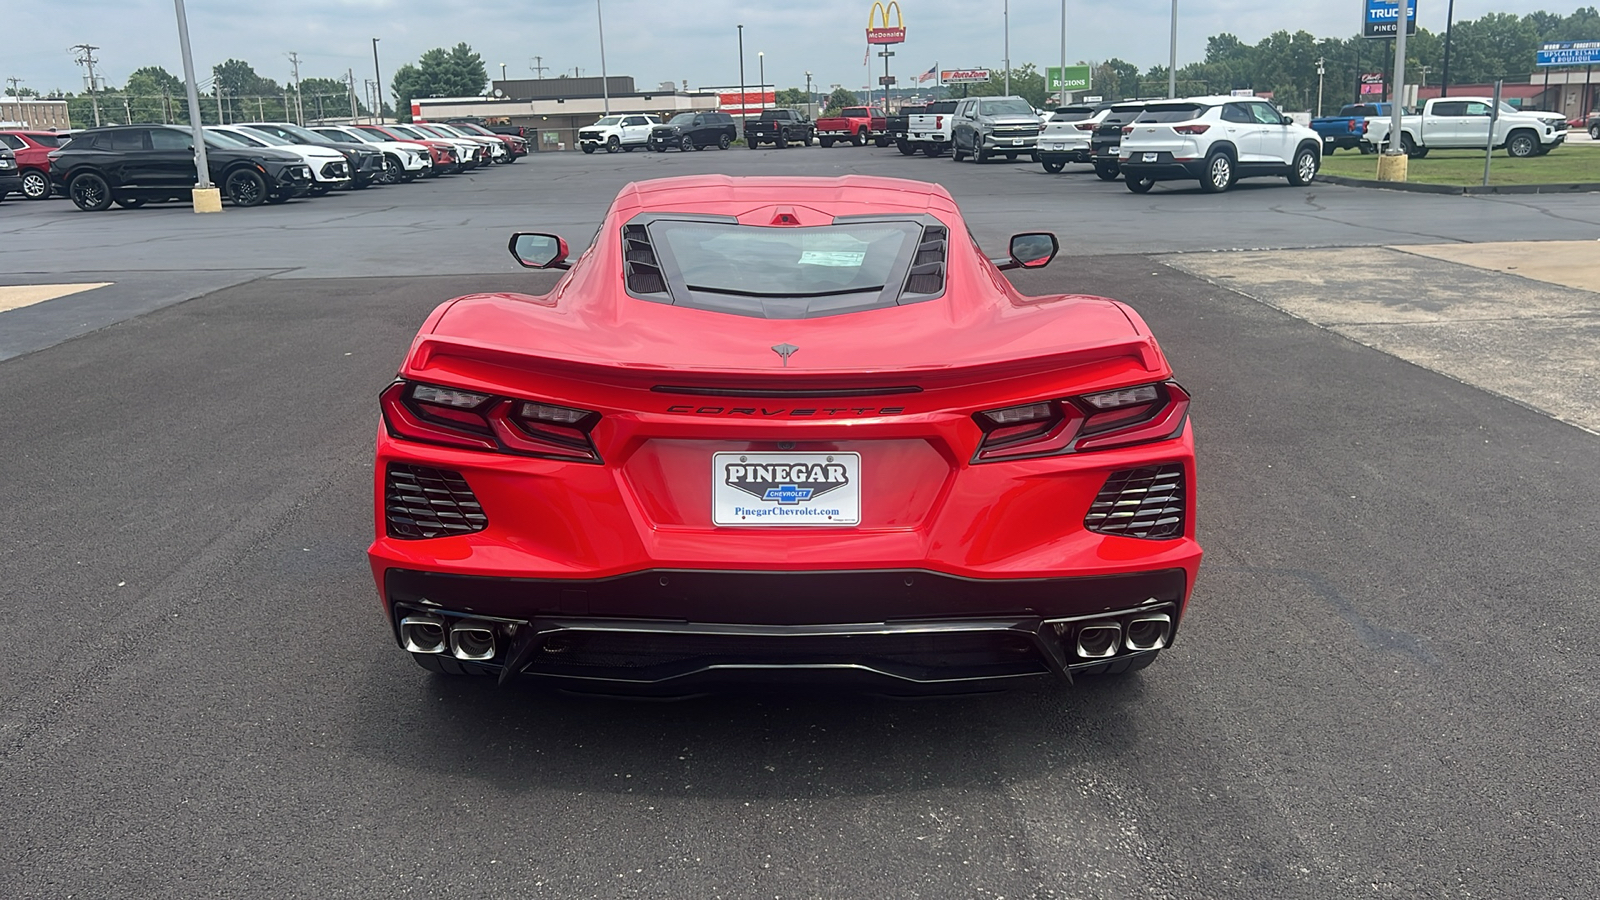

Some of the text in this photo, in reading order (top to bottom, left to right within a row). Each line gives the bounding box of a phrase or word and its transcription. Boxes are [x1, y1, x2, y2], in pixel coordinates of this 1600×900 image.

[1370, 8, 1414, 18] TRUCS
[1373, 24, 1398, 32] PINEG
[666, 405, 905, 416] CORVETTE
[728, 466, 847, 483] PINEGAR
[735, 507, 840, 517] PinegarChevrolet.com
